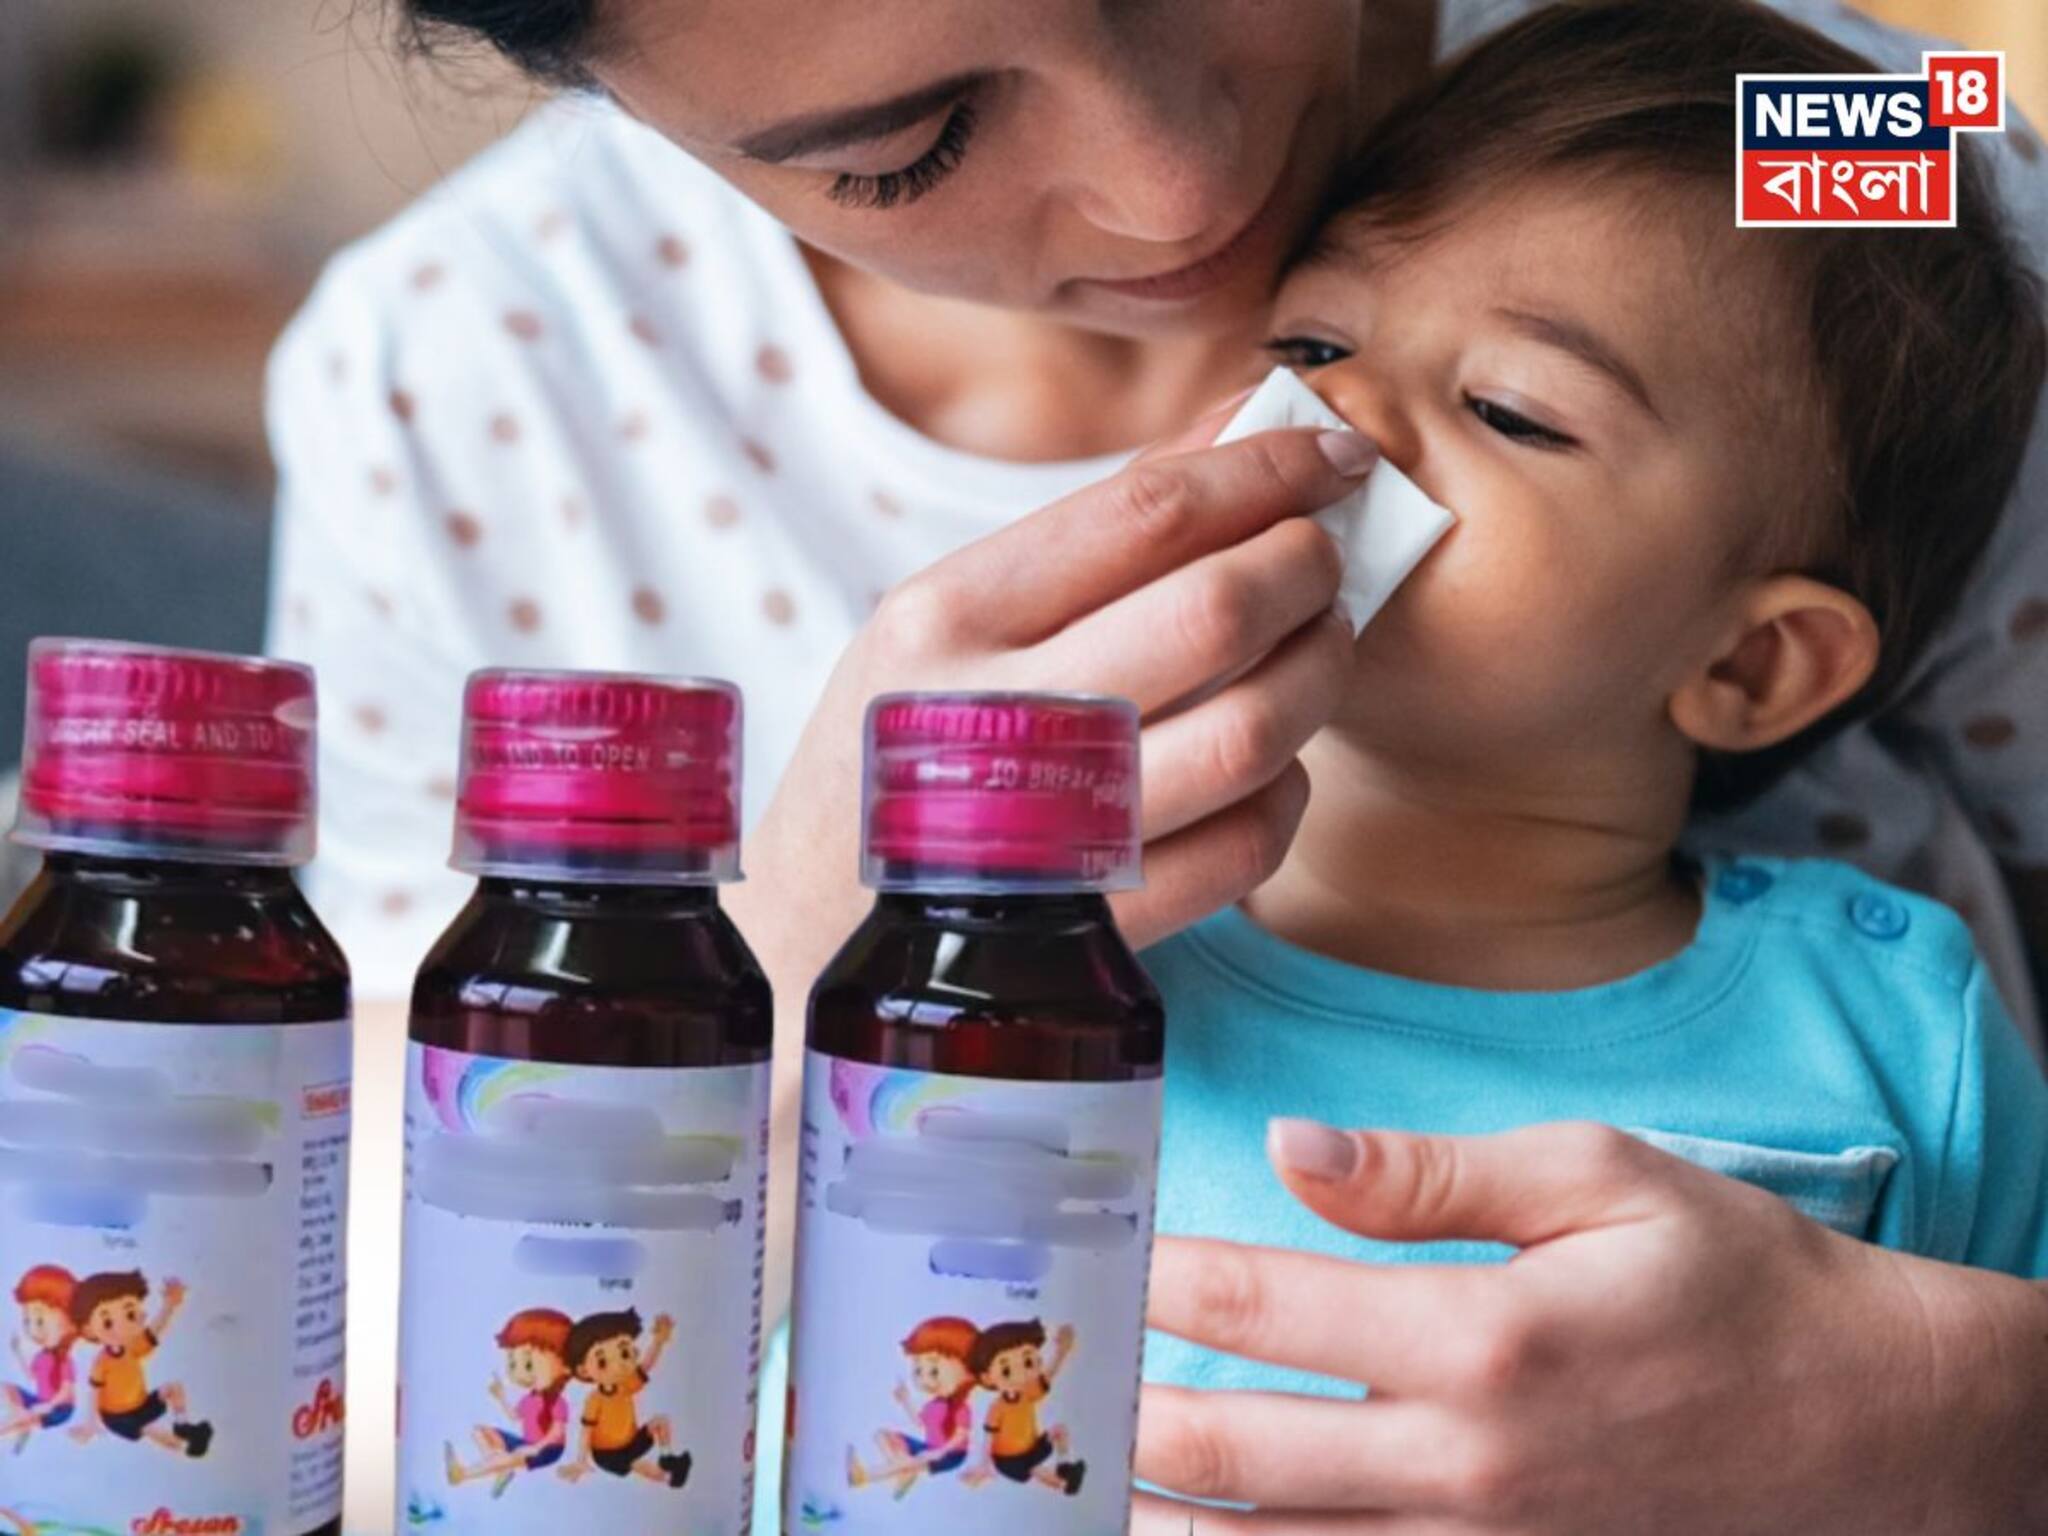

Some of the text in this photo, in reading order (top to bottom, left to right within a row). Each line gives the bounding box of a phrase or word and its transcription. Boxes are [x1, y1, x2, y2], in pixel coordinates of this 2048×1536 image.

[124, 719, 182, 750] SEAL
[193, 720, 240, 752] AND
[591, 743, 652, 772] OPEN
